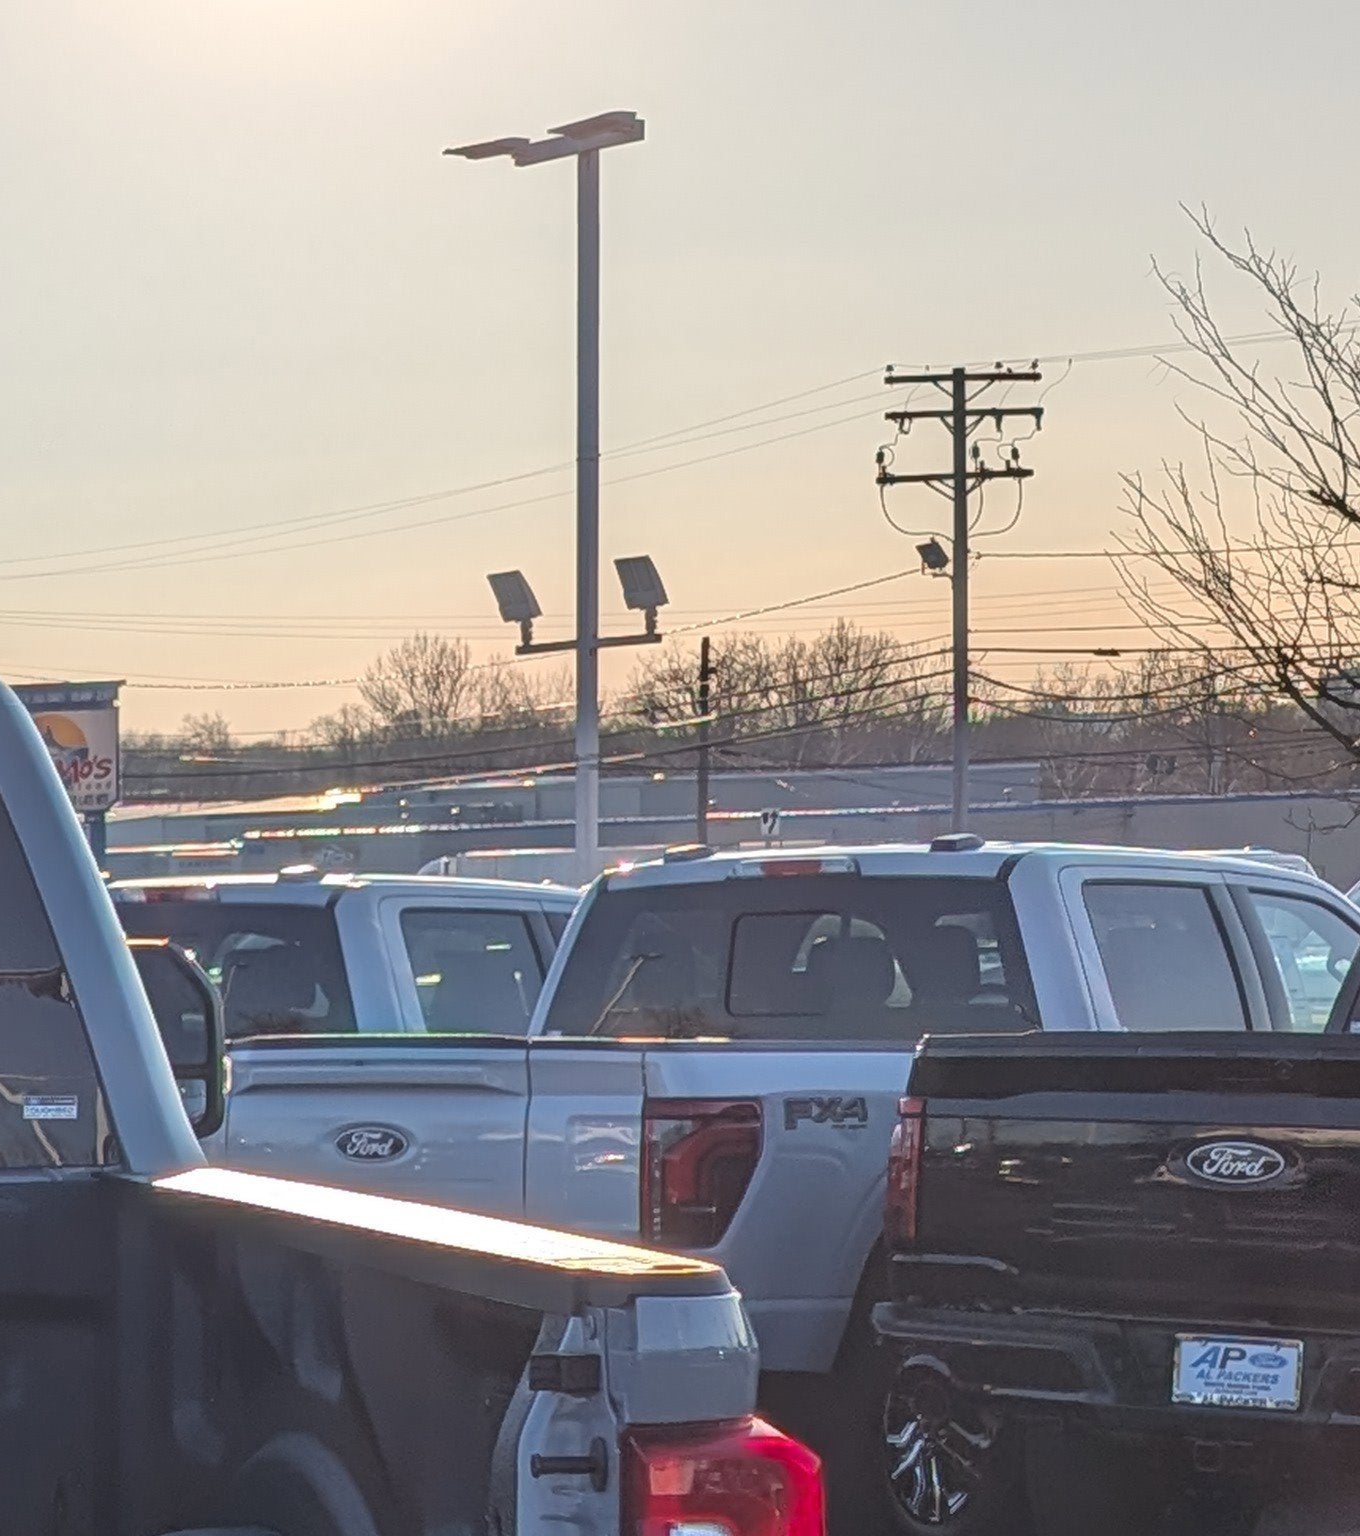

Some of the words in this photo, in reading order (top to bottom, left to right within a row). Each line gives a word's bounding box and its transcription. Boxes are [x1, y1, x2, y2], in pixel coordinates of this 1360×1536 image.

[783, 1097, 868, 1130] FX4
[346, 1131, 395, 1156] Ford
[1202, 1147, 1266, 1176] Ford
[1189, 1346, 1247, 1369] AP
[1195, 1368, 1212, 1380] AL
